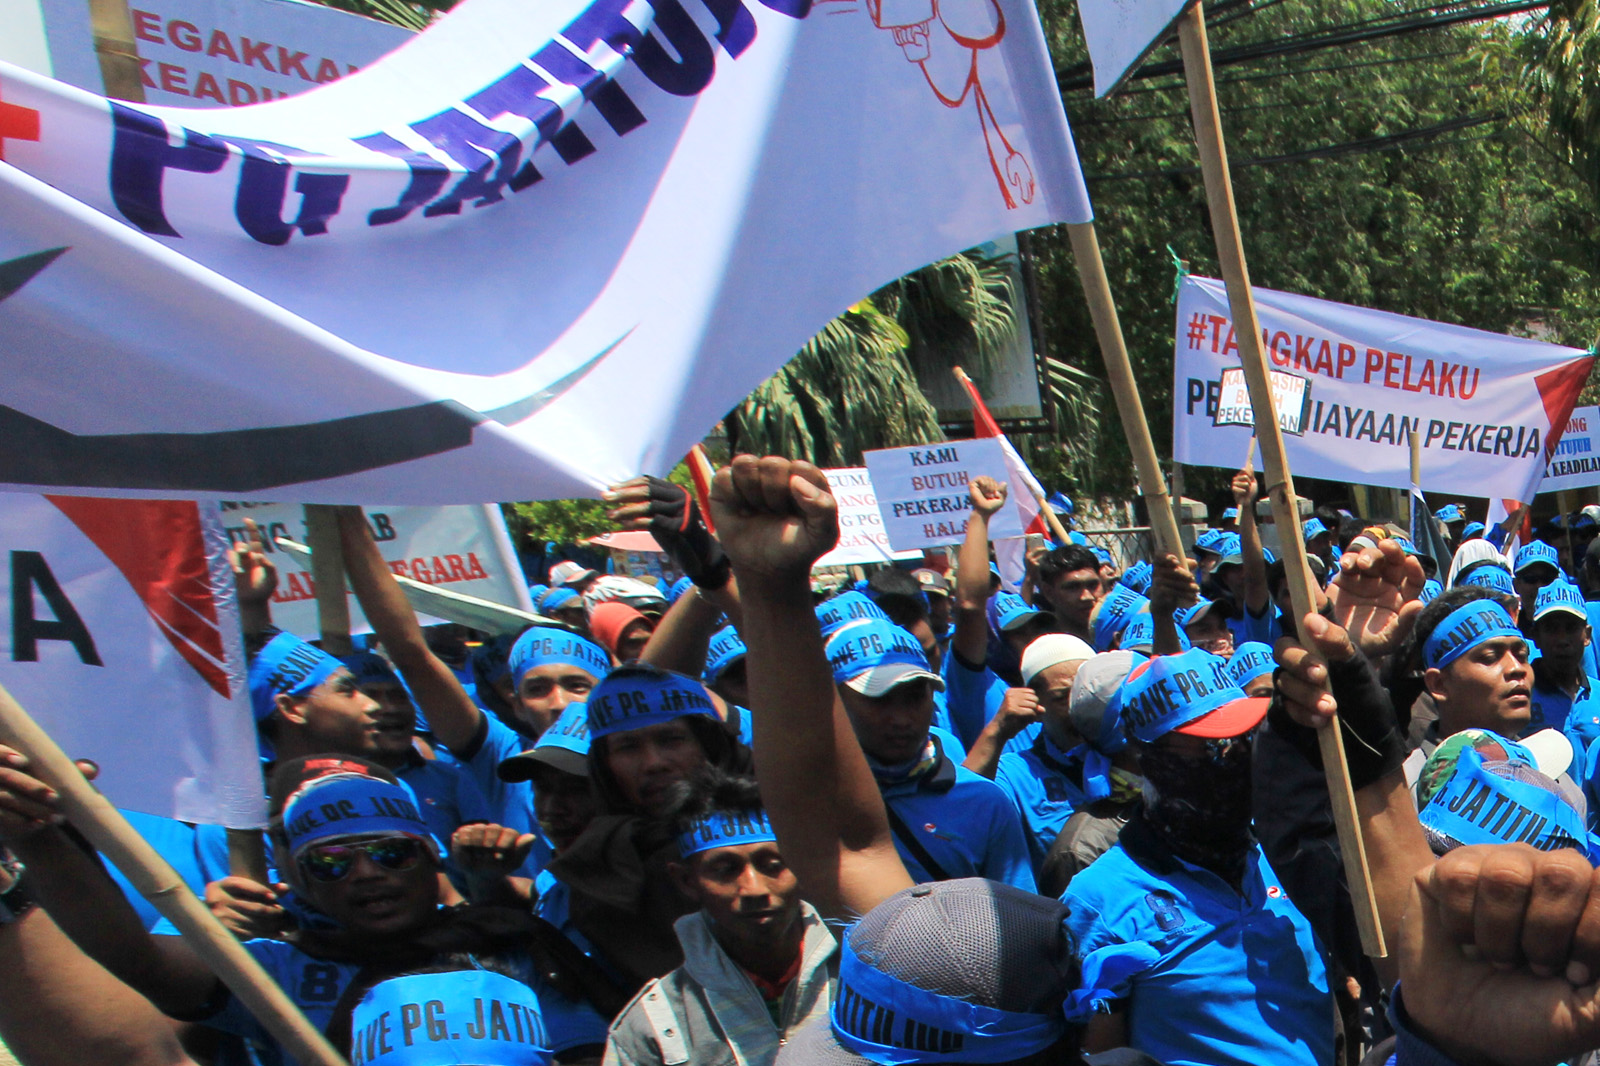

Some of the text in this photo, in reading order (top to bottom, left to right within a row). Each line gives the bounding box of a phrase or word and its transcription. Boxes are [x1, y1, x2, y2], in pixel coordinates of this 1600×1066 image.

[132, 9, 352, 84] EGAKKA
[1187, 312, 1480, 401] #TAGKAP PELAKU
[1271, 373, 1305, 395] ASIH
[910, 448, 959, 467] KAMI
[1424, 420, 1542, 460] PEKERJA
[912, 471, 969, 491] BUTUH
[923, 517, 969, 539] HALA
[387, 552, 489, 586] EGARA
[1173, 668, 1214, 704] PG.
[400, 998, 460, 1048] PG.
